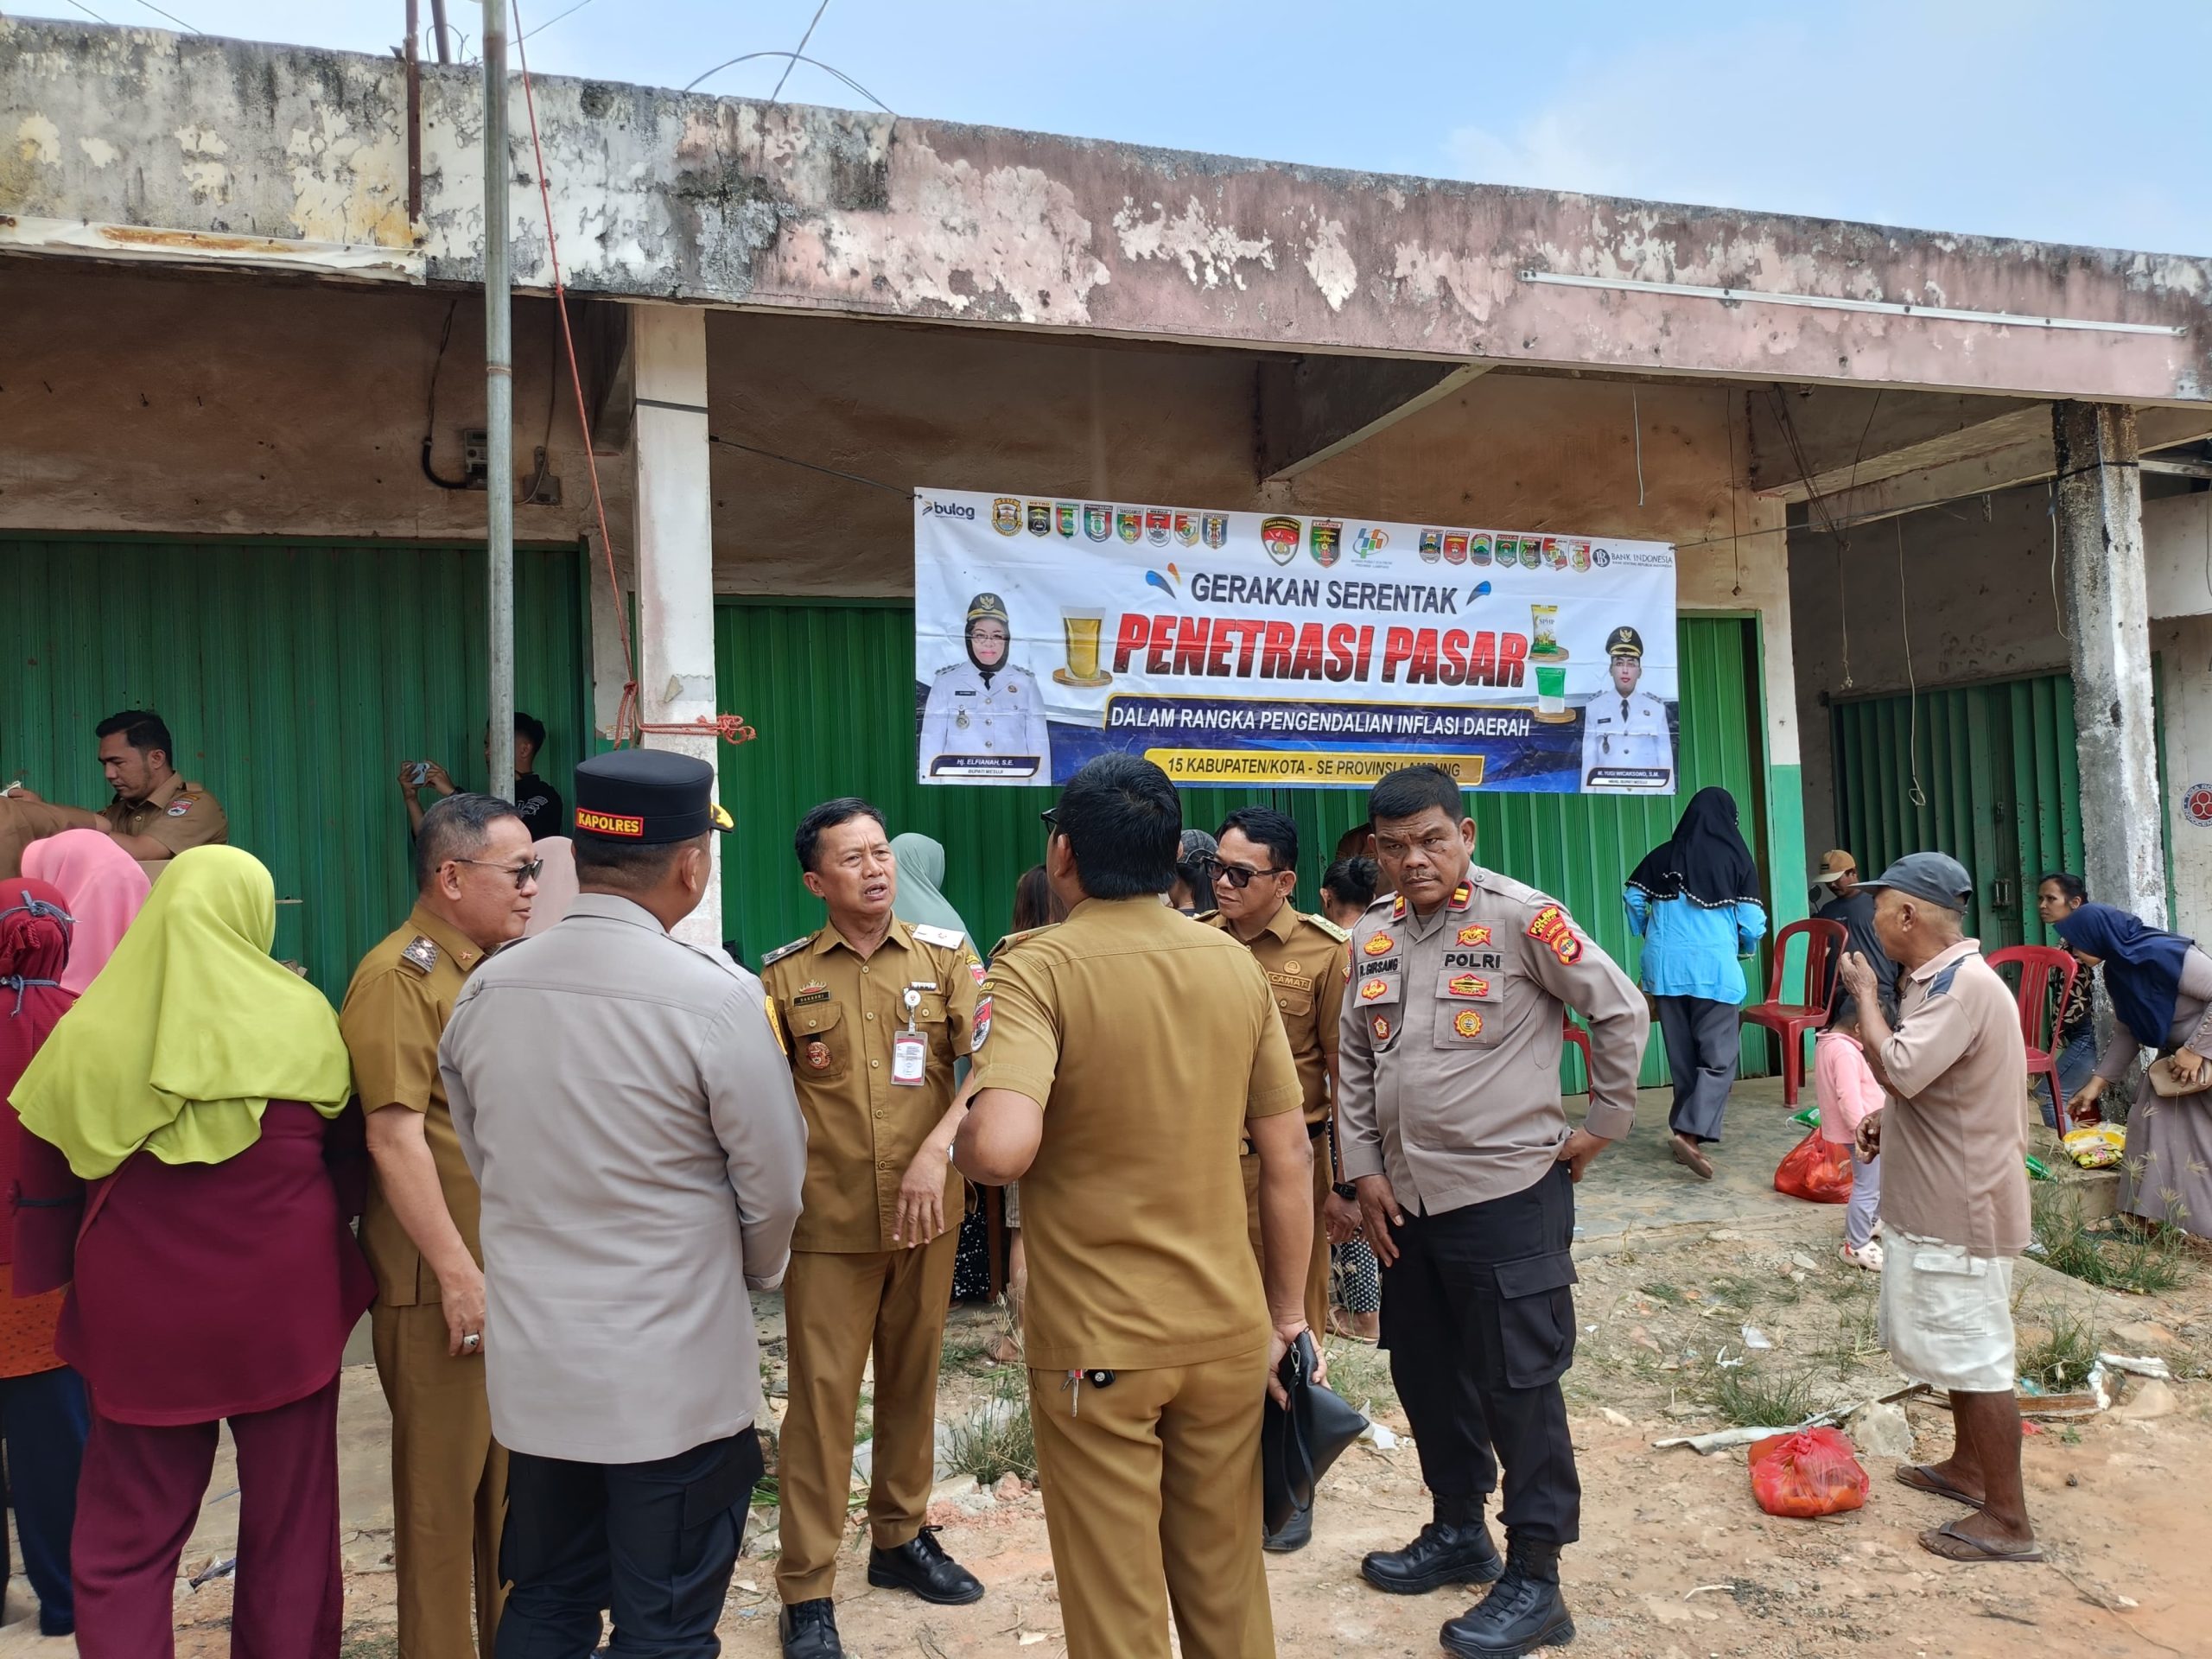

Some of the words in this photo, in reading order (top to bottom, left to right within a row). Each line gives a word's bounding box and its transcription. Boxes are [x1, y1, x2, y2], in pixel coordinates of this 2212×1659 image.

[934, 501, 975, 520] bulog
[1634, 555, 1673, 563] INDONESIA
[1191, 573, 1319, 607] GERAKAN
[1326, 581, 1458, 614] SERENTAK
[1113, 613, 1375, 682] PENETRASI
[1381, 626, 1528, 687] PASAR
[1110, 707, 1175, 728] DALAM
[1180, 709, 1255, 729] RANGKA
[1259, 711, 1393, 733] PENGENDALIAN
[1397, 715, 1459, 734] INFLASI
[1464, 717, 1530, 736] DAERAH
[1167, 757, 1183, 772] 15
[1186, 758, 1305, 774] KABUPATEN/KOTA
[1316, 760, 1332, 775] SE
[1337, 760, 1397, 776] PROVINSI
[578, 812, 639, 833] KAPOLRES
[1530, 907, 1557, 934] POLRES
[1366, 958, 1398, 976] GIRSANG
[1445, 953, 1501, 969] POLRI
[1271, 975, 1306, 988] CAMAT
